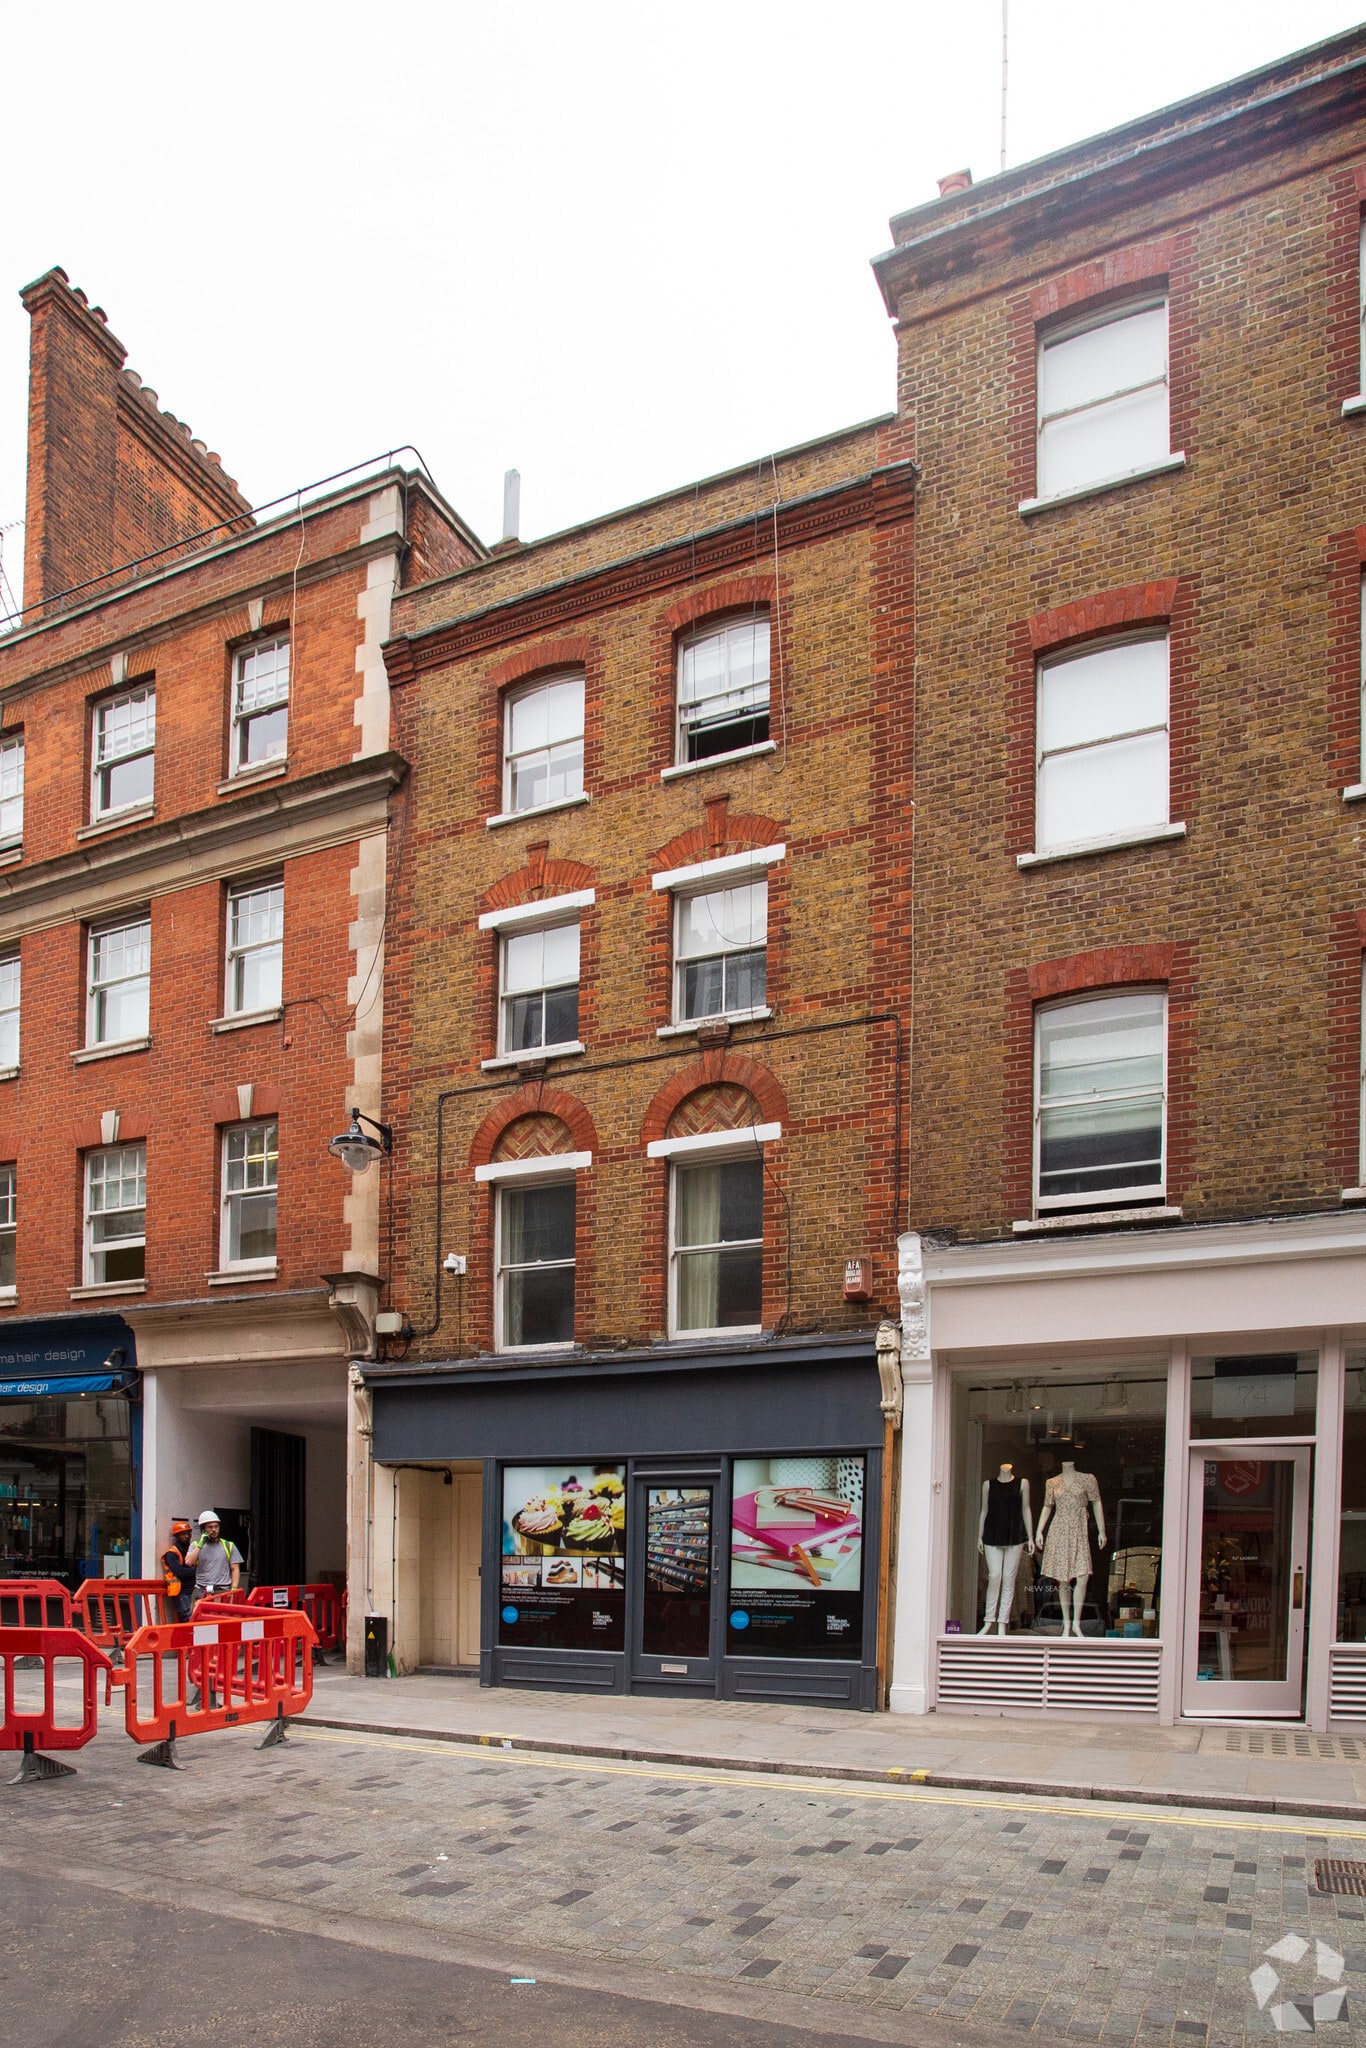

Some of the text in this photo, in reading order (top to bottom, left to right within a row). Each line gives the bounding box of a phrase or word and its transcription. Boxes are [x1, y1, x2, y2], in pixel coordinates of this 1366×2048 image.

[847, 1260, 860, 1270] AFA
[16, 1351, 40, 1363] hair
[44, 1348, 86, 1361] design
[17, 1381, 49, 1394] design
[1024, 1585, 1075, 1593] NEW SEASON
